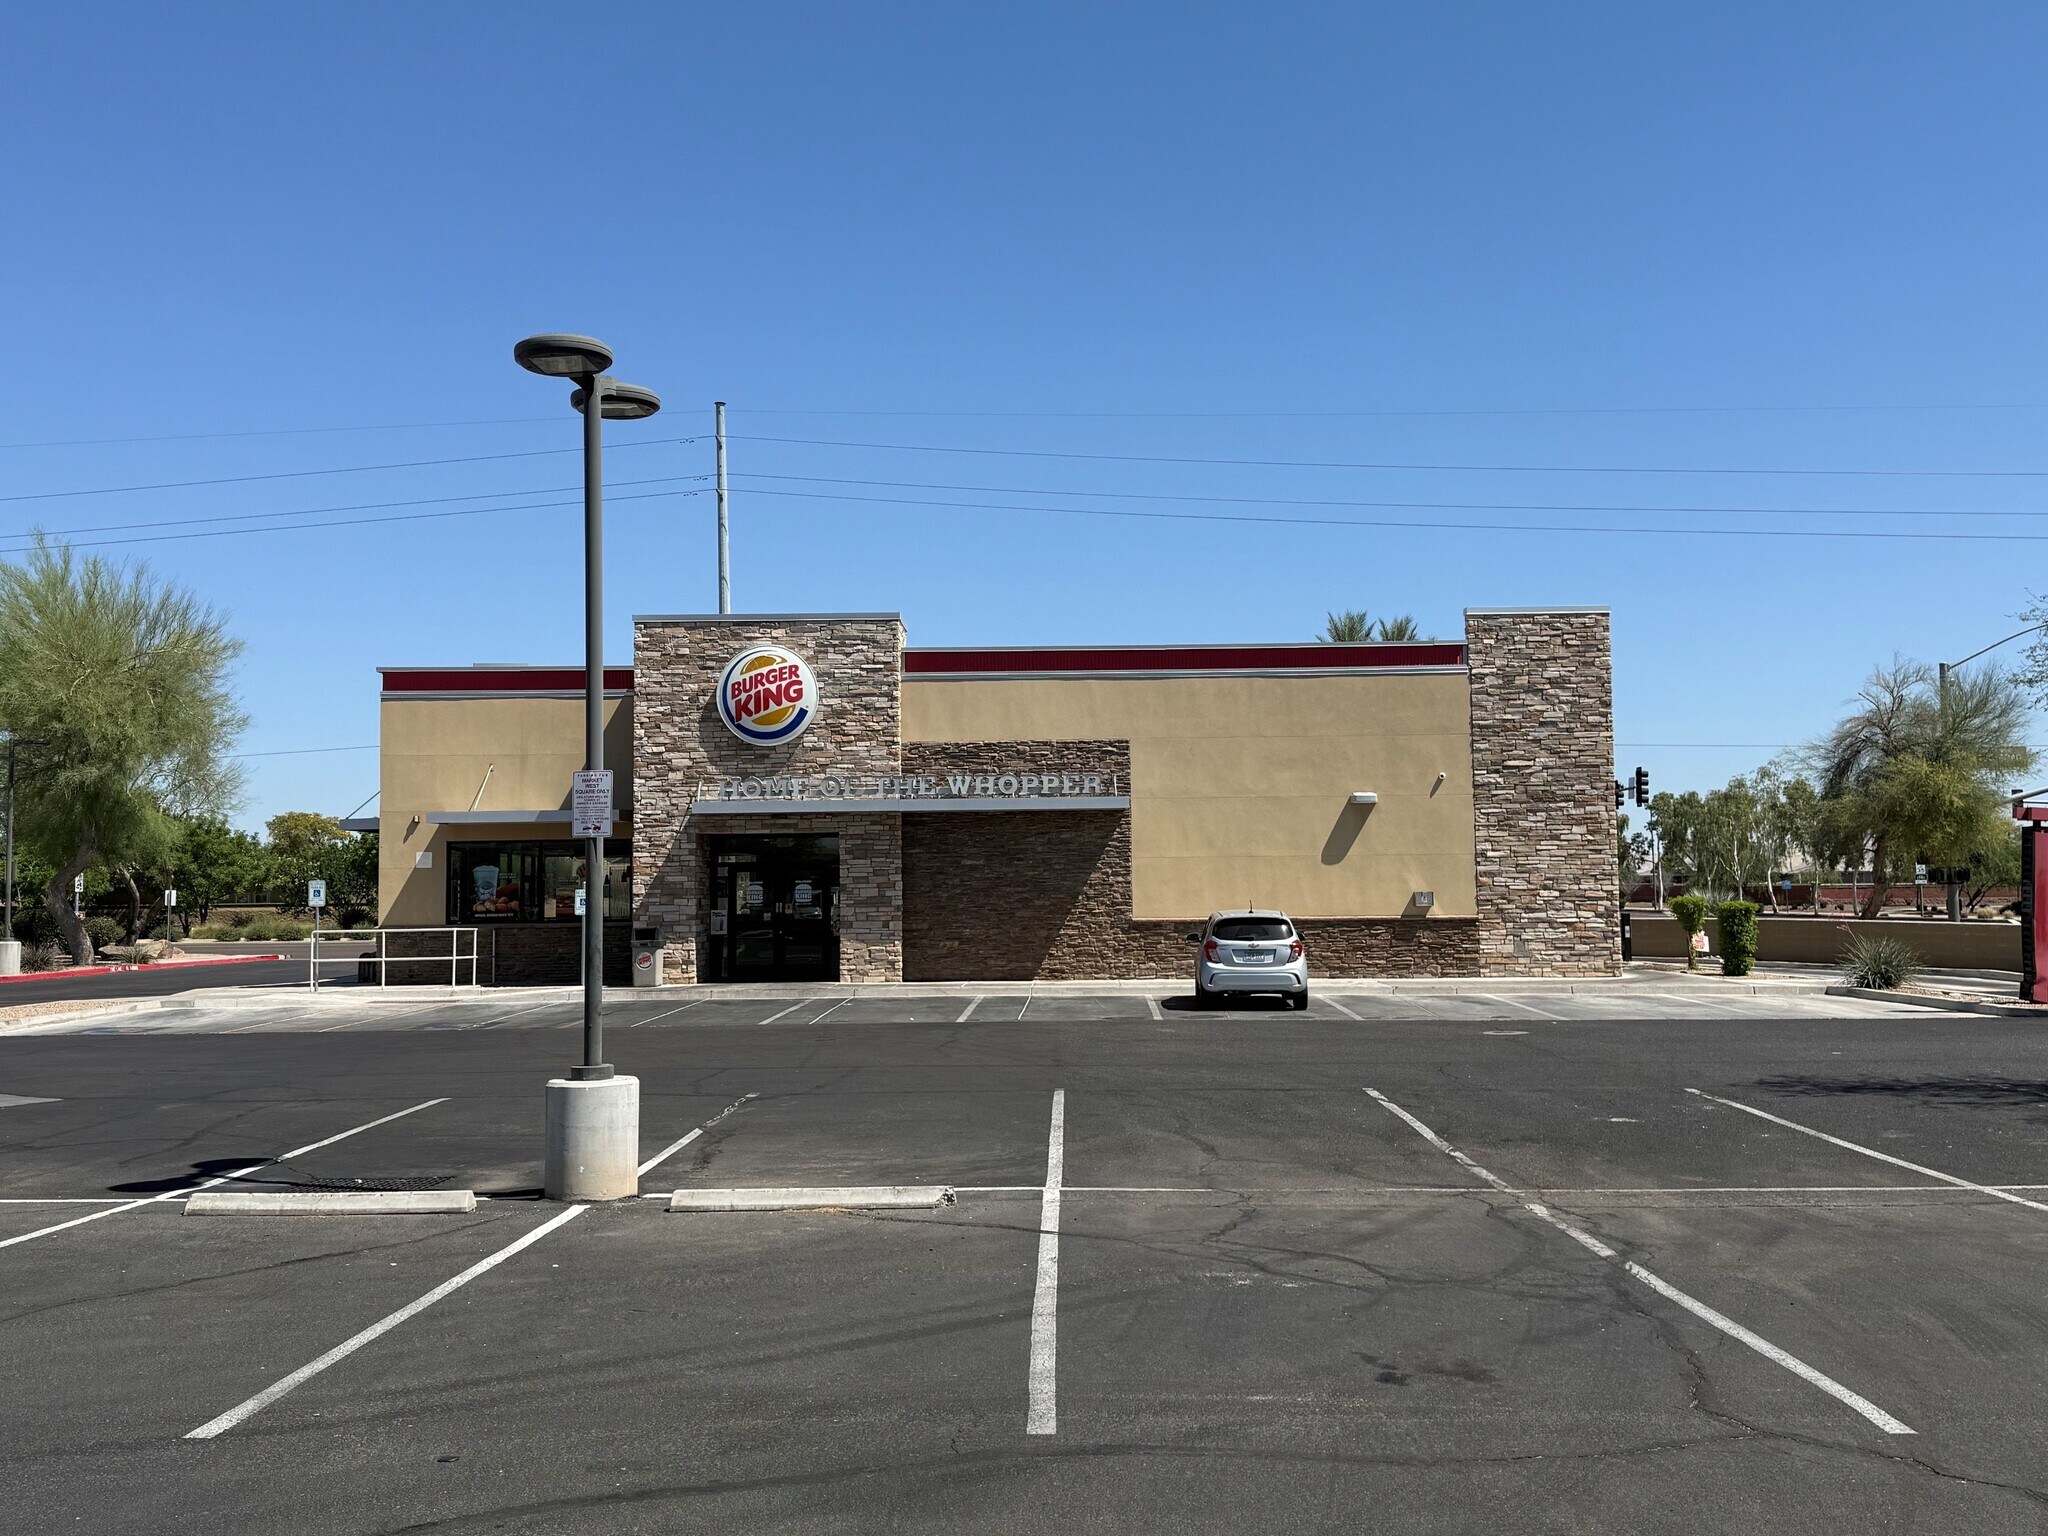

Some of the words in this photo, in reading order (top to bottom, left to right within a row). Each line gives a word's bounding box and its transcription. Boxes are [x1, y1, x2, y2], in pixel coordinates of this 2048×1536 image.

[731, 664, 800, 700] BURGER
[734, 679, 804, 724] KING
[718, 775, 810, 798] HOME
[873, 774, 937, 796] THE
[947, 772, 1103, 795] WHOPPER
